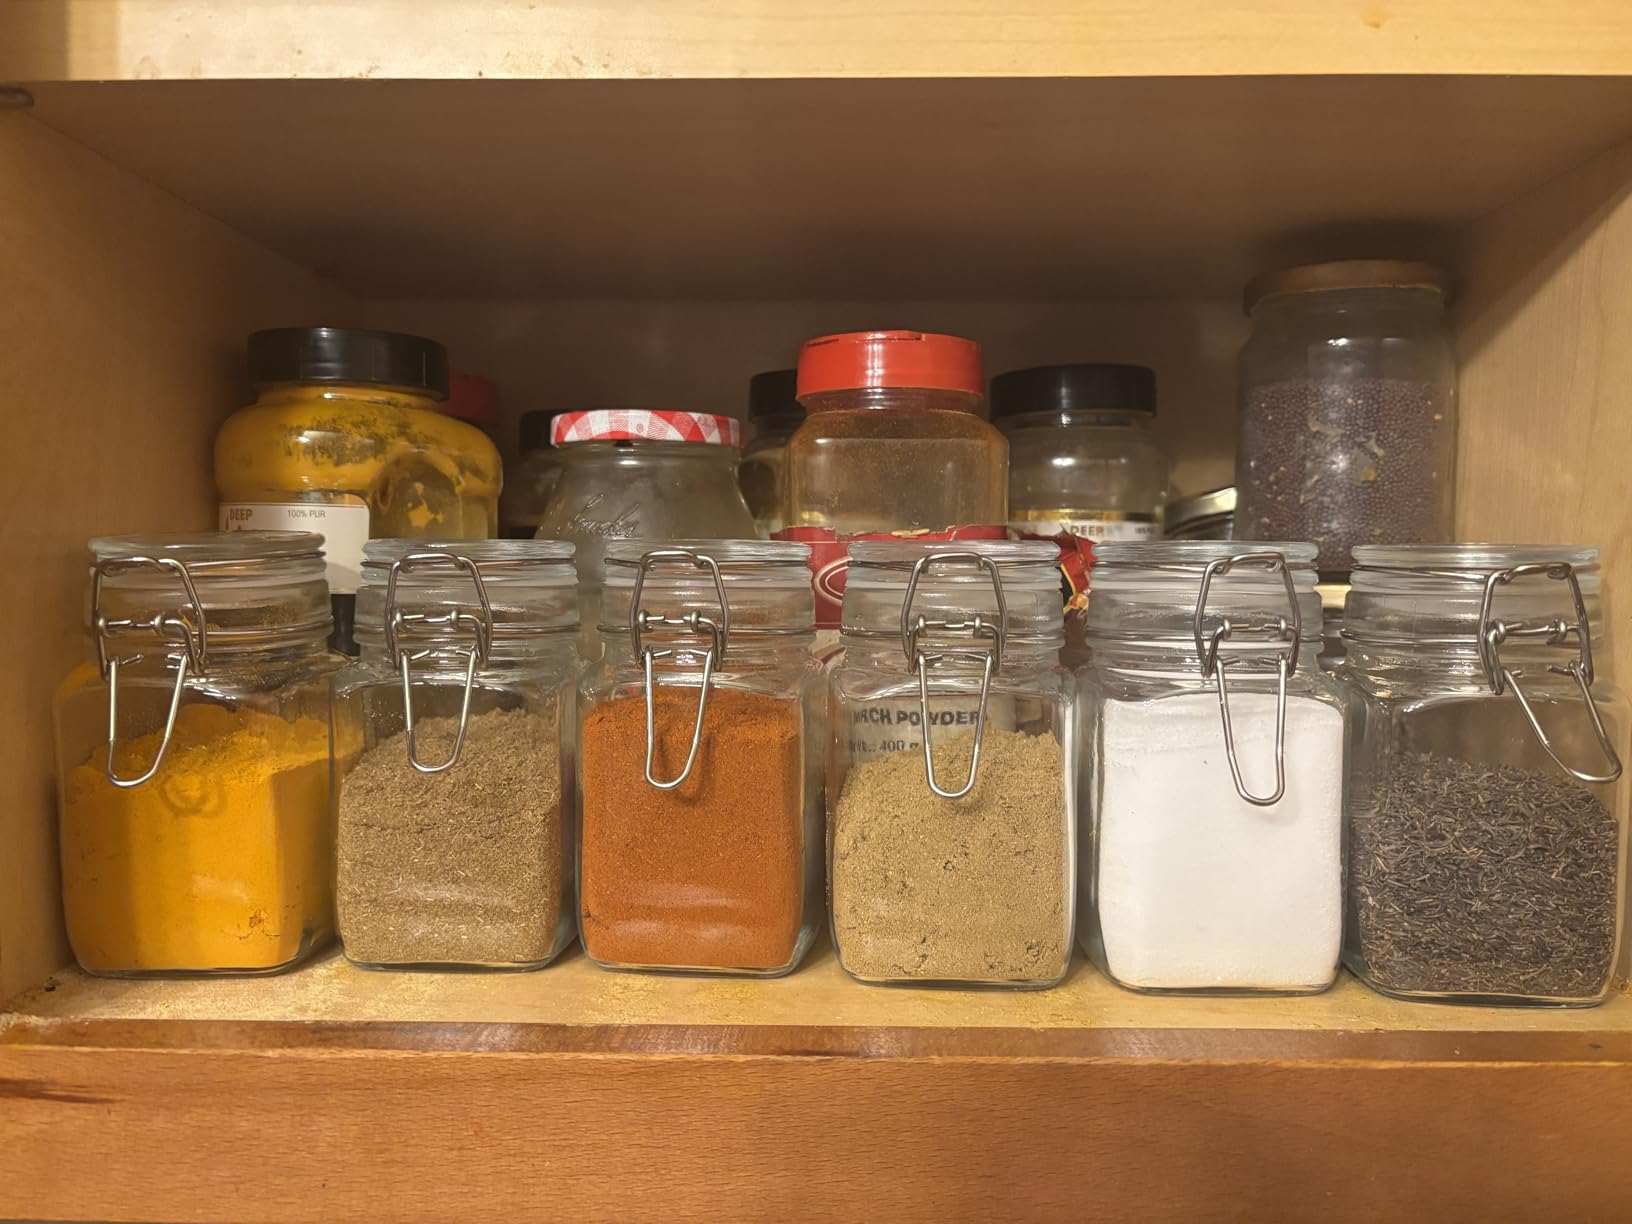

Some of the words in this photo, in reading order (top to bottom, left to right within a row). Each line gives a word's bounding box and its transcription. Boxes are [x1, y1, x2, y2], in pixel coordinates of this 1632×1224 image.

[229, 508, 253, 521] DEEP
[287, 509, 307, 518] 100%
[879, 740, 905, 752] 400
